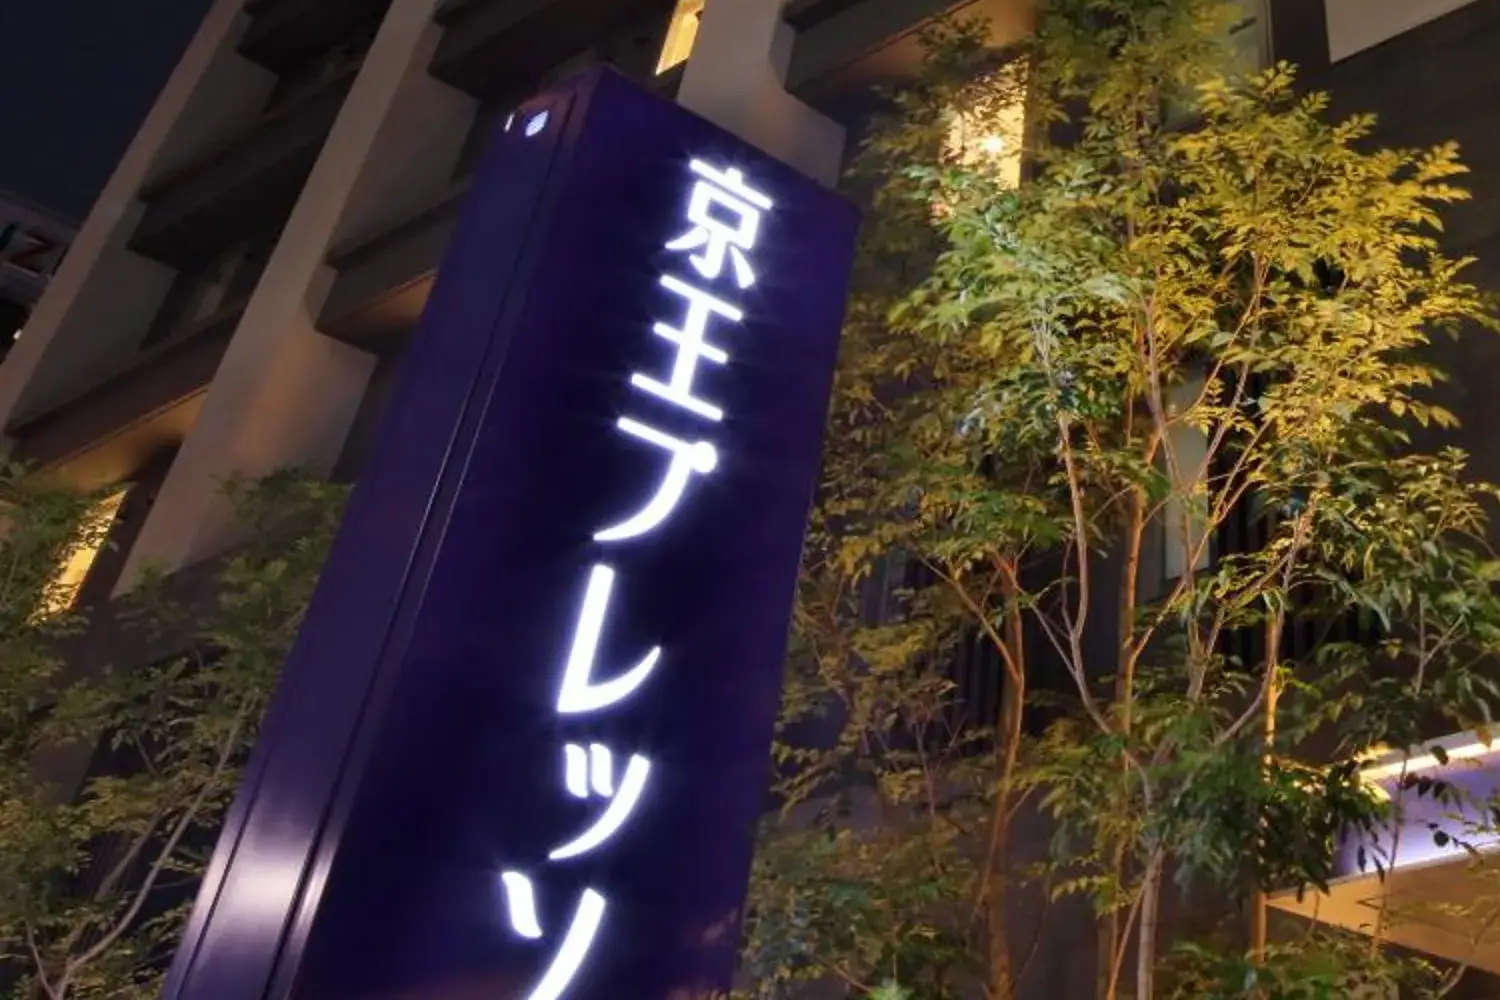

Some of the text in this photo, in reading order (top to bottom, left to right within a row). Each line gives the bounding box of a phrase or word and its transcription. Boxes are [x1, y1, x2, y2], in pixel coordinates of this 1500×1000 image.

[501, 158, 774, 1000] 京王プレッソ
